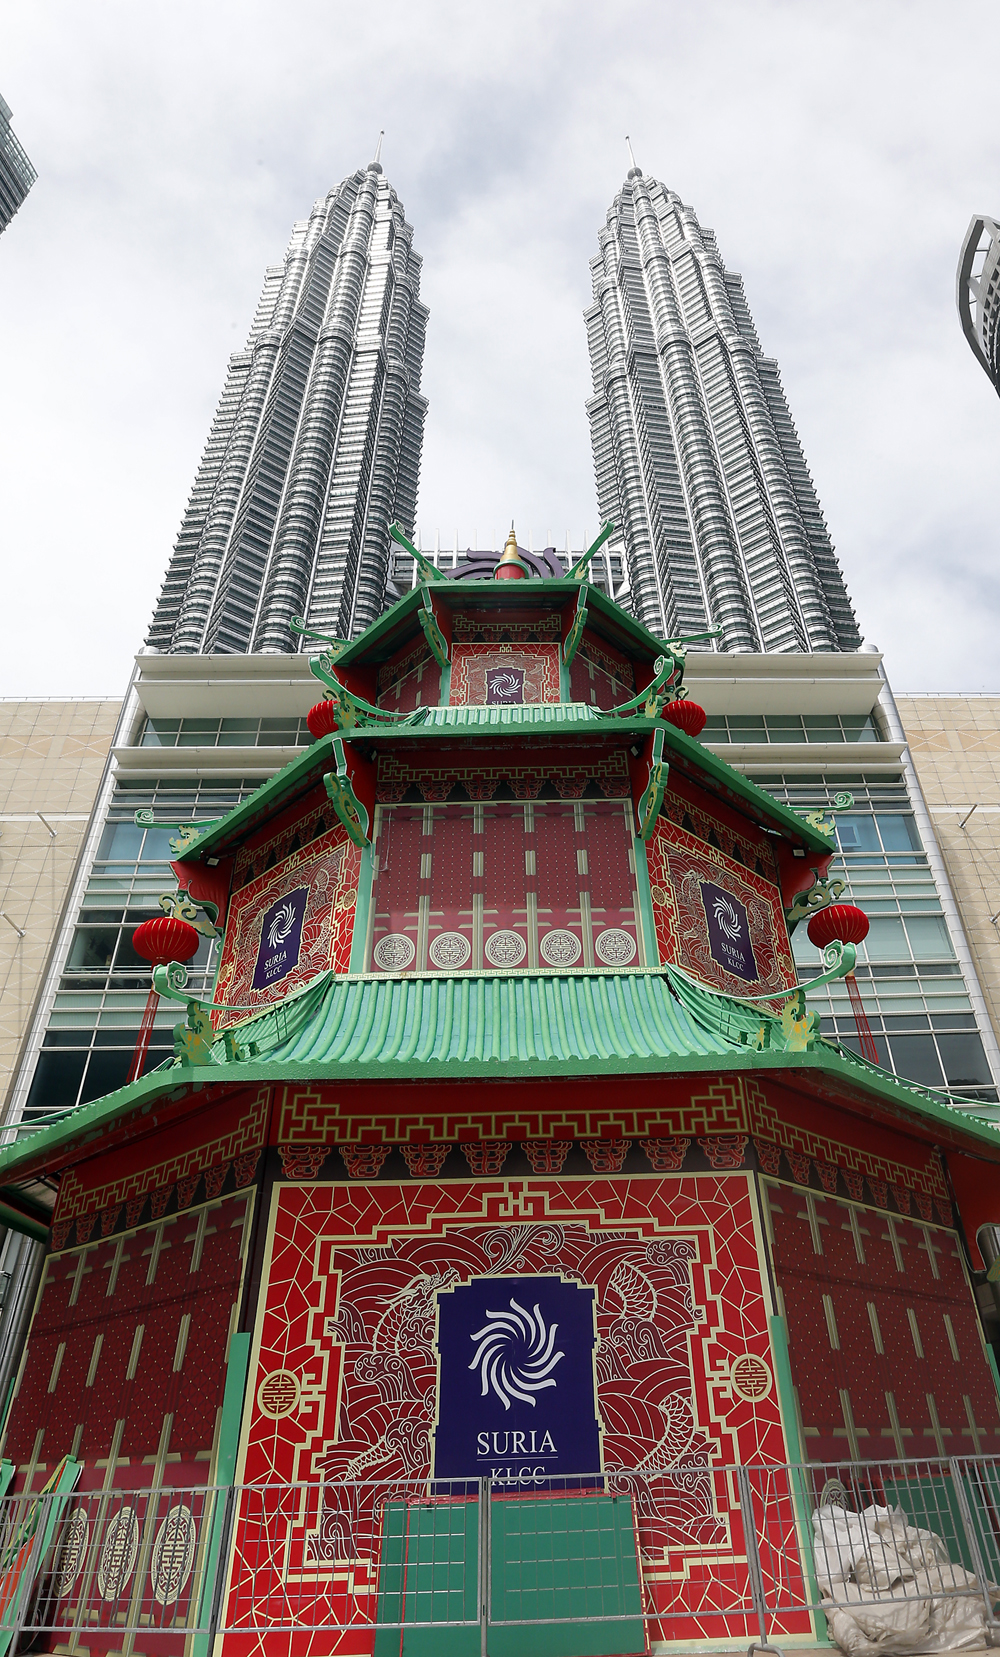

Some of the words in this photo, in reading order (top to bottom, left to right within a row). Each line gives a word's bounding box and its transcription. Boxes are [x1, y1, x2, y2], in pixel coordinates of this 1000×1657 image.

[264, 951, 287, 970] SURIA
[721, 942, 745, 962] SURIA
[266, 965, 283, 980] KLCC
[727, 957, 744, 971] KLCC
[477, 1430, 558, 1455] SURIA
[491, 1466, 546, 1486] KLCC
